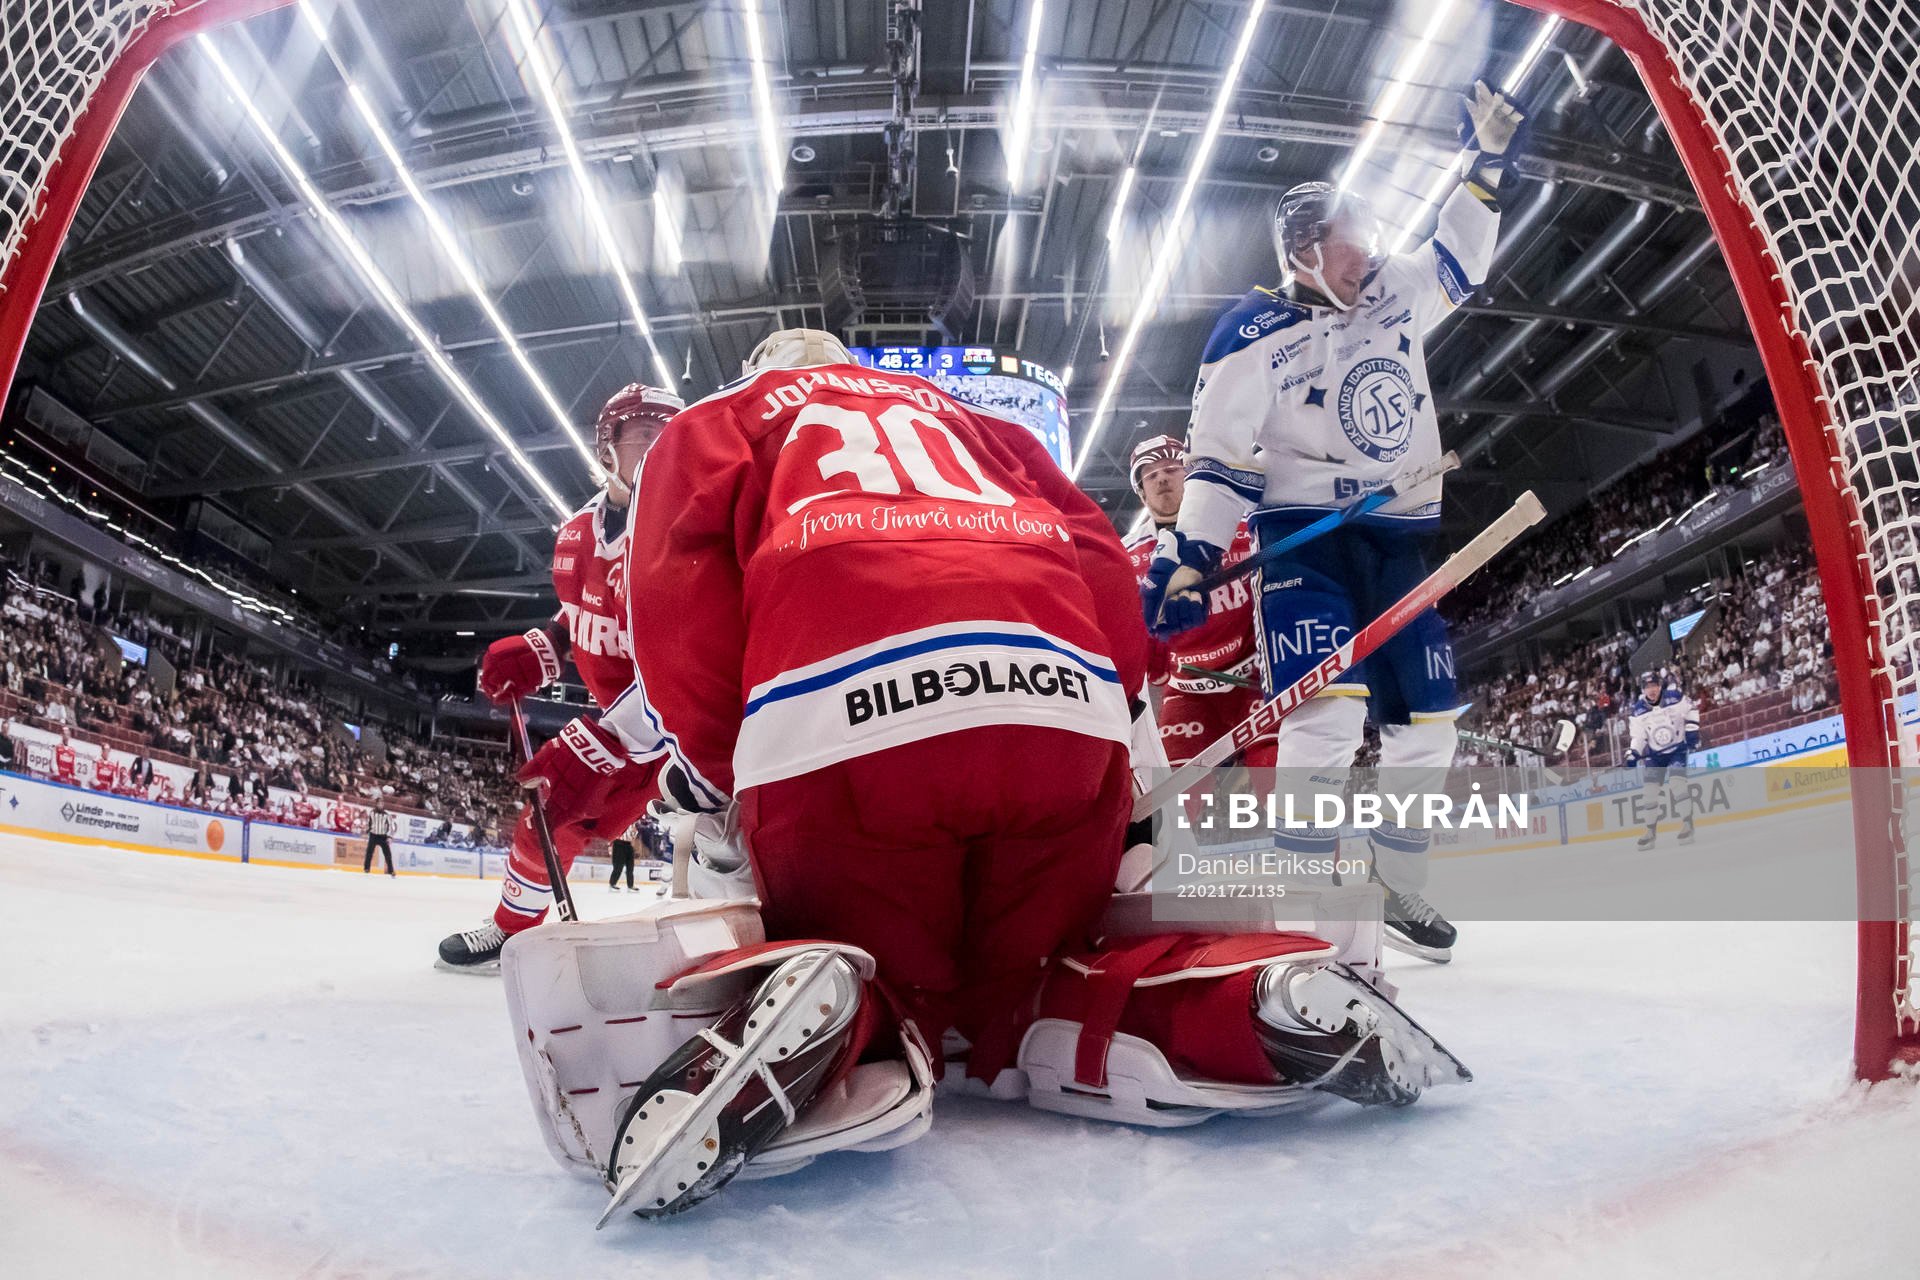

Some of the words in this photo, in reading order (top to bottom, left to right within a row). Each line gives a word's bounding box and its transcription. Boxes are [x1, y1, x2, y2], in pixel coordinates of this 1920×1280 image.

[1253, 310, 1275, 323] Clas
[1260, 311, 1292, 329] Ohlson
[941, 354, 953, 369] 3
[761, 371, 960, 421] JOHANSSON
[779, 402, 1016, 516] 30
[801, 510, 865, 551] from
[871, 506, 953, 531] Timrå
[956, 510, 1010, 533] with
[1012, 511, 1054, 538] love
[526, 631, 557, 681] BAUE
[1177, 658, 1256, 692] BILBOLGET
[845, 660, 1090, 727] BILBOLAGET
[1231, 656, 1345, 751] BAUER
[1158, 721, 1205, 738] oop
[563, 723, 616, 776] BAUE
[75, 814, 140, 833] Entreprenad
[76, 803, 104, 817] Linde
